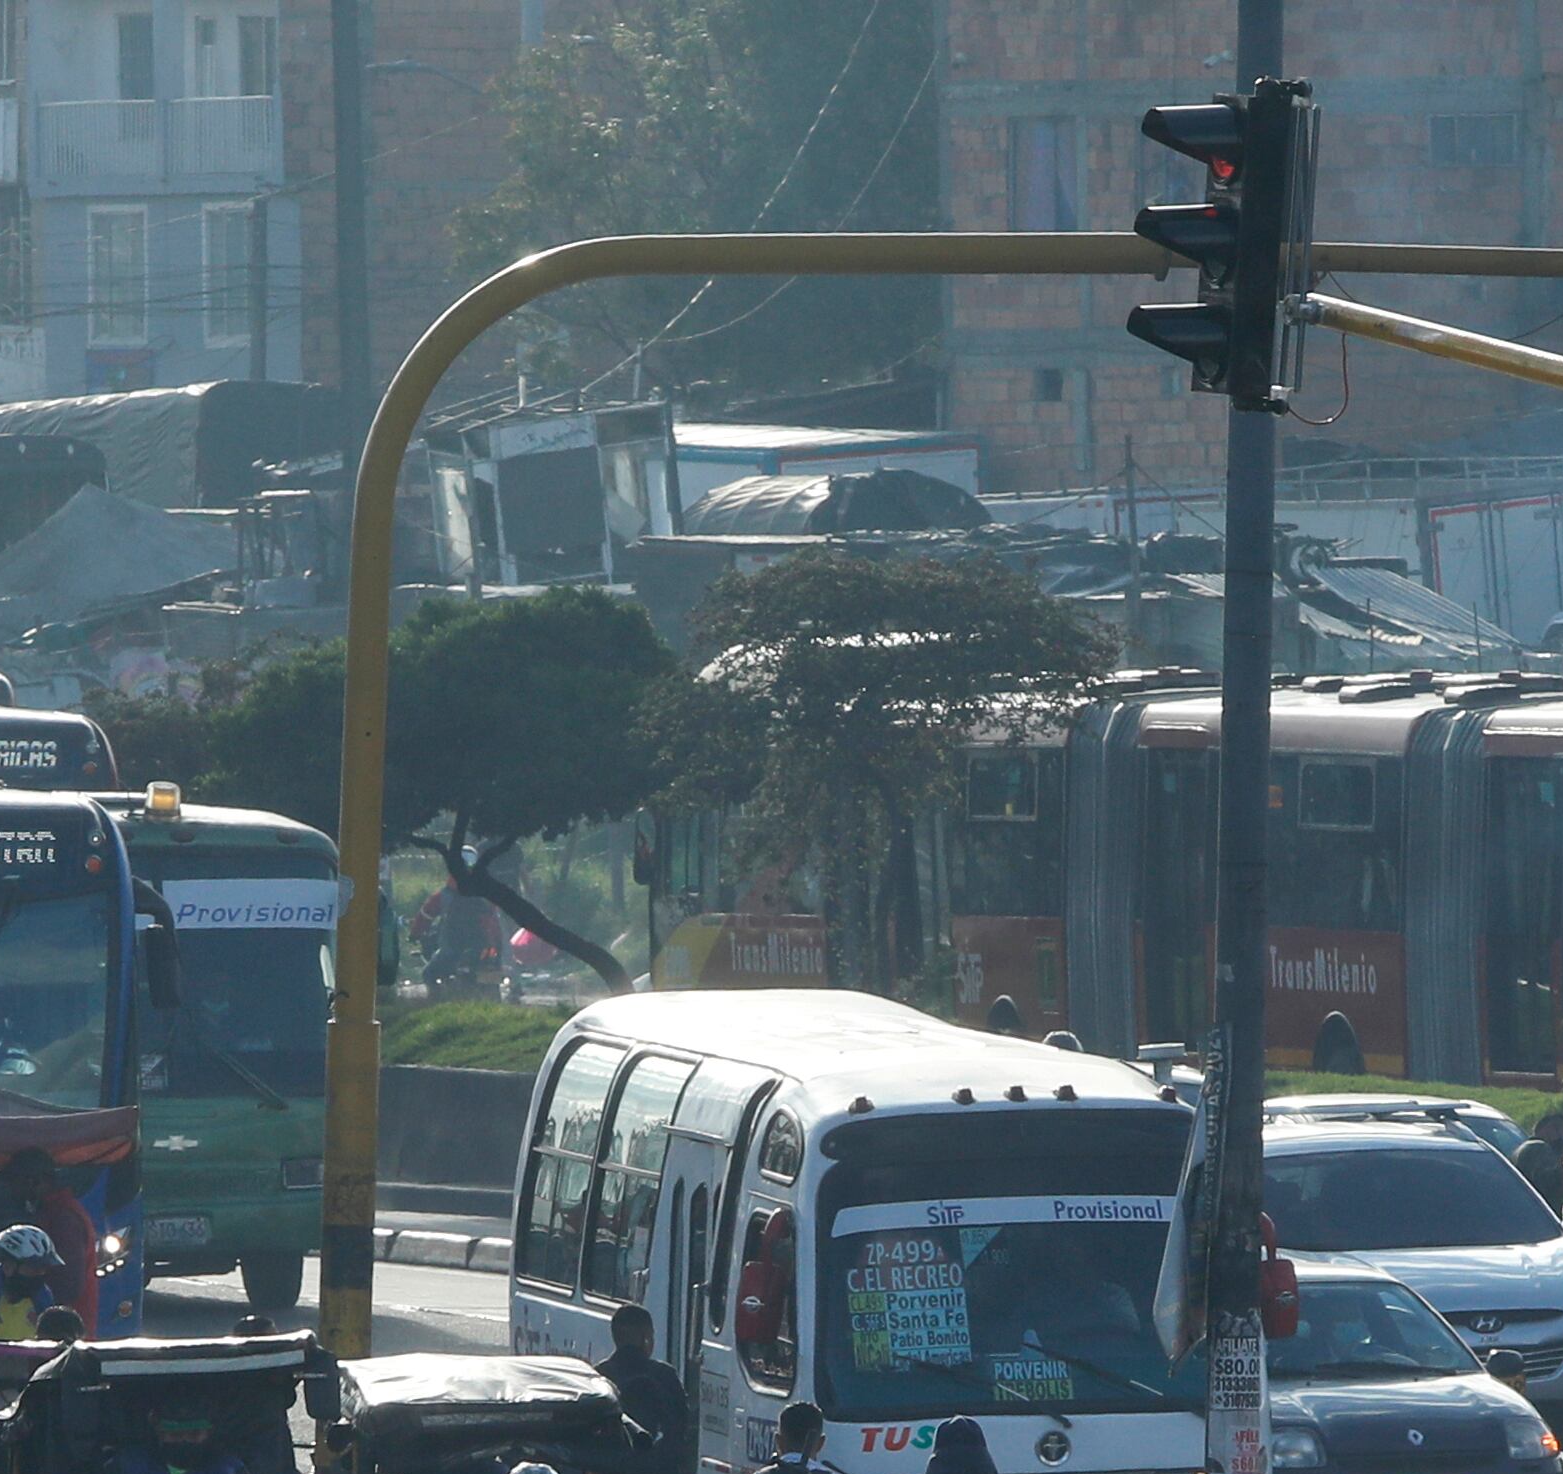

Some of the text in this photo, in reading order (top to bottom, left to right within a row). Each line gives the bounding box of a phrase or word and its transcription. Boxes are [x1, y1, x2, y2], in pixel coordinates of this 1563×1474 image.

[176, 902, 333, 924] Provisional
[1269, 945, 1377, 995] TransMilenio
[927, 1199, 1163, 1225] SiTP Provisional
[892, 1263, 963, 1290] RECREO
[886, 1288, 964, 1310] Porvenir
[889, 1311, 940, 1329] Santa
[945, 1309, 966, 1326] Fe
[890, 1330, 968, 1347] Patio Bonito
[994, 1361, 1069, 1381] PORVENIR
